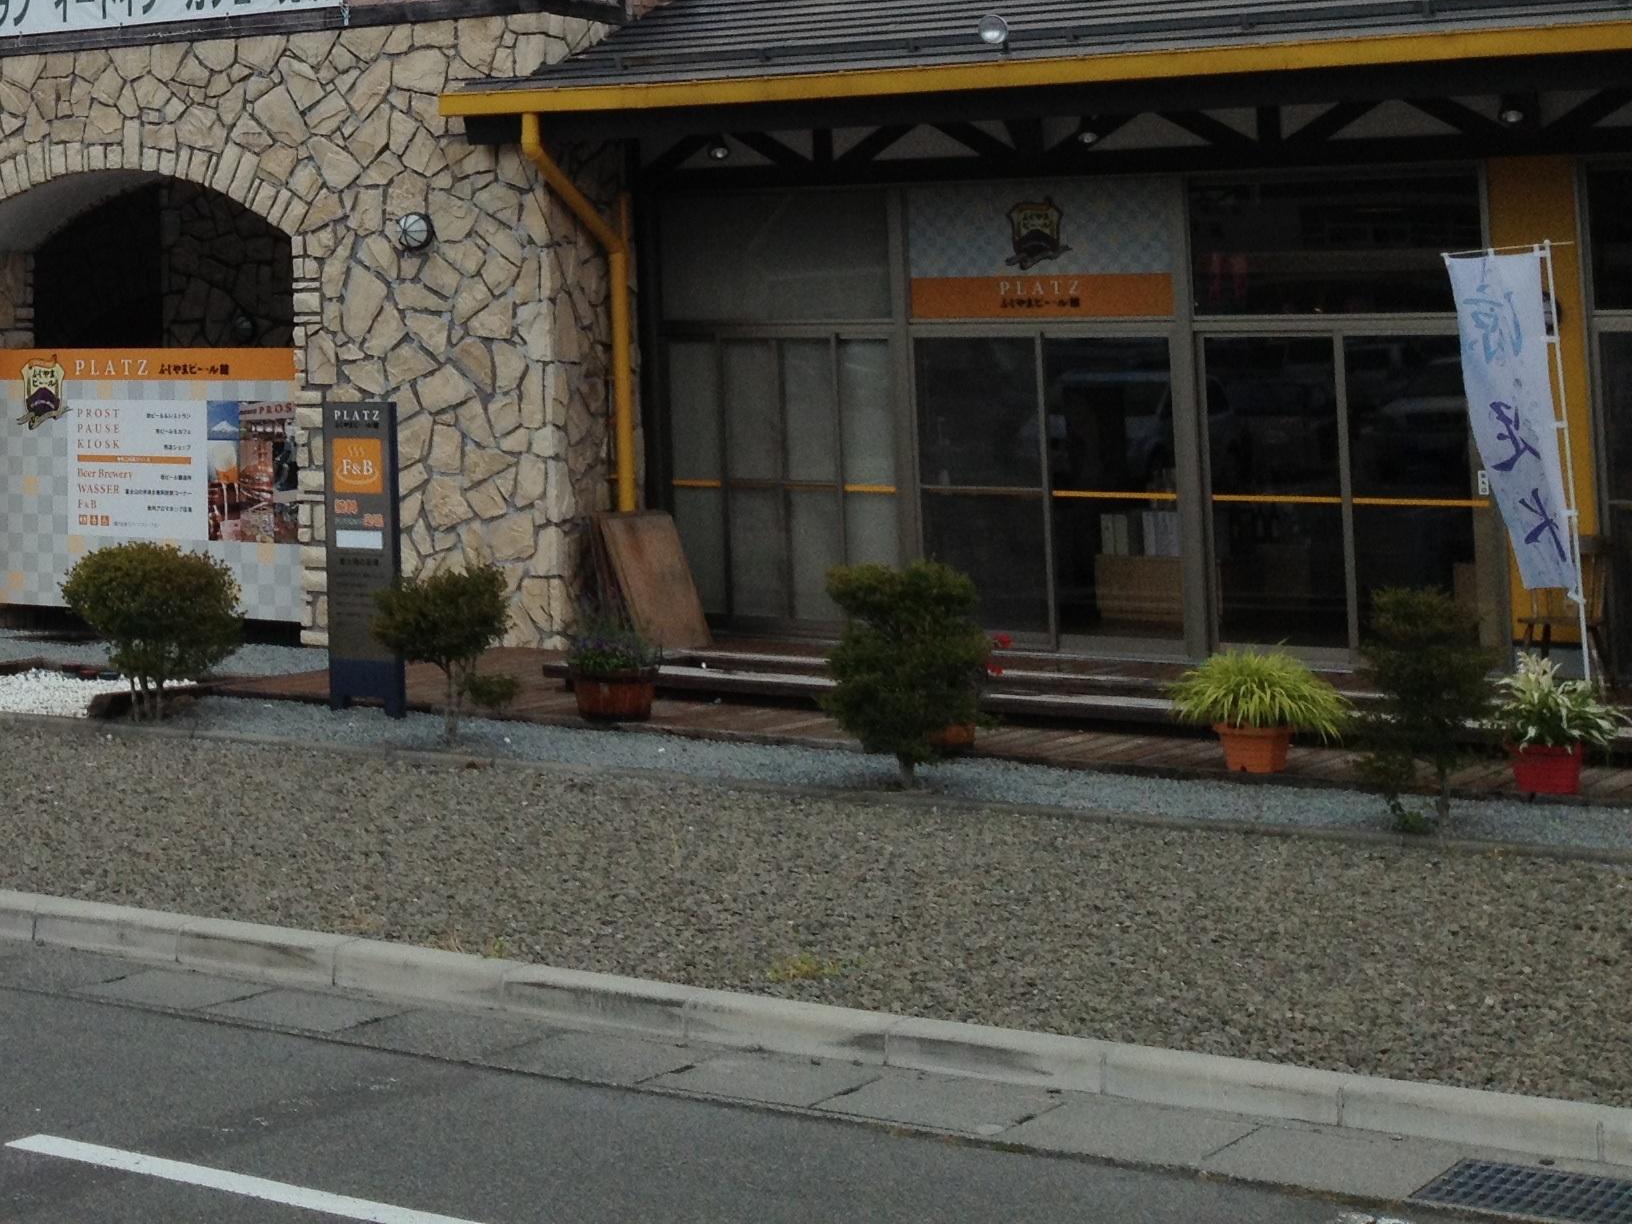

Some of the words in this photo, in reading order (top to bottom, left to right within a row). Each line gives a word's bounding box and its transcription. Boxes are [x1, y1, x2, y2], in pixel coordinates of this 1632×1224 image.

[999, 280, 1079, 295] PLATZ
[75, 359, 149, 376] PLATZ
[77, 408, 120, 418] PROST
[334, 410, 380, 421] PLATZ
[77, 423, 120, 433] PAUSE
[77, 439, 120, 449] KIOSK
[342, 459, 374, 475] F&B
[77, 468, 96, 478] Beer
[98, 469, 133, 481] Brewery
[77, 484, 120, 494] WASSER
[77, 500, 97, 509] F&B
